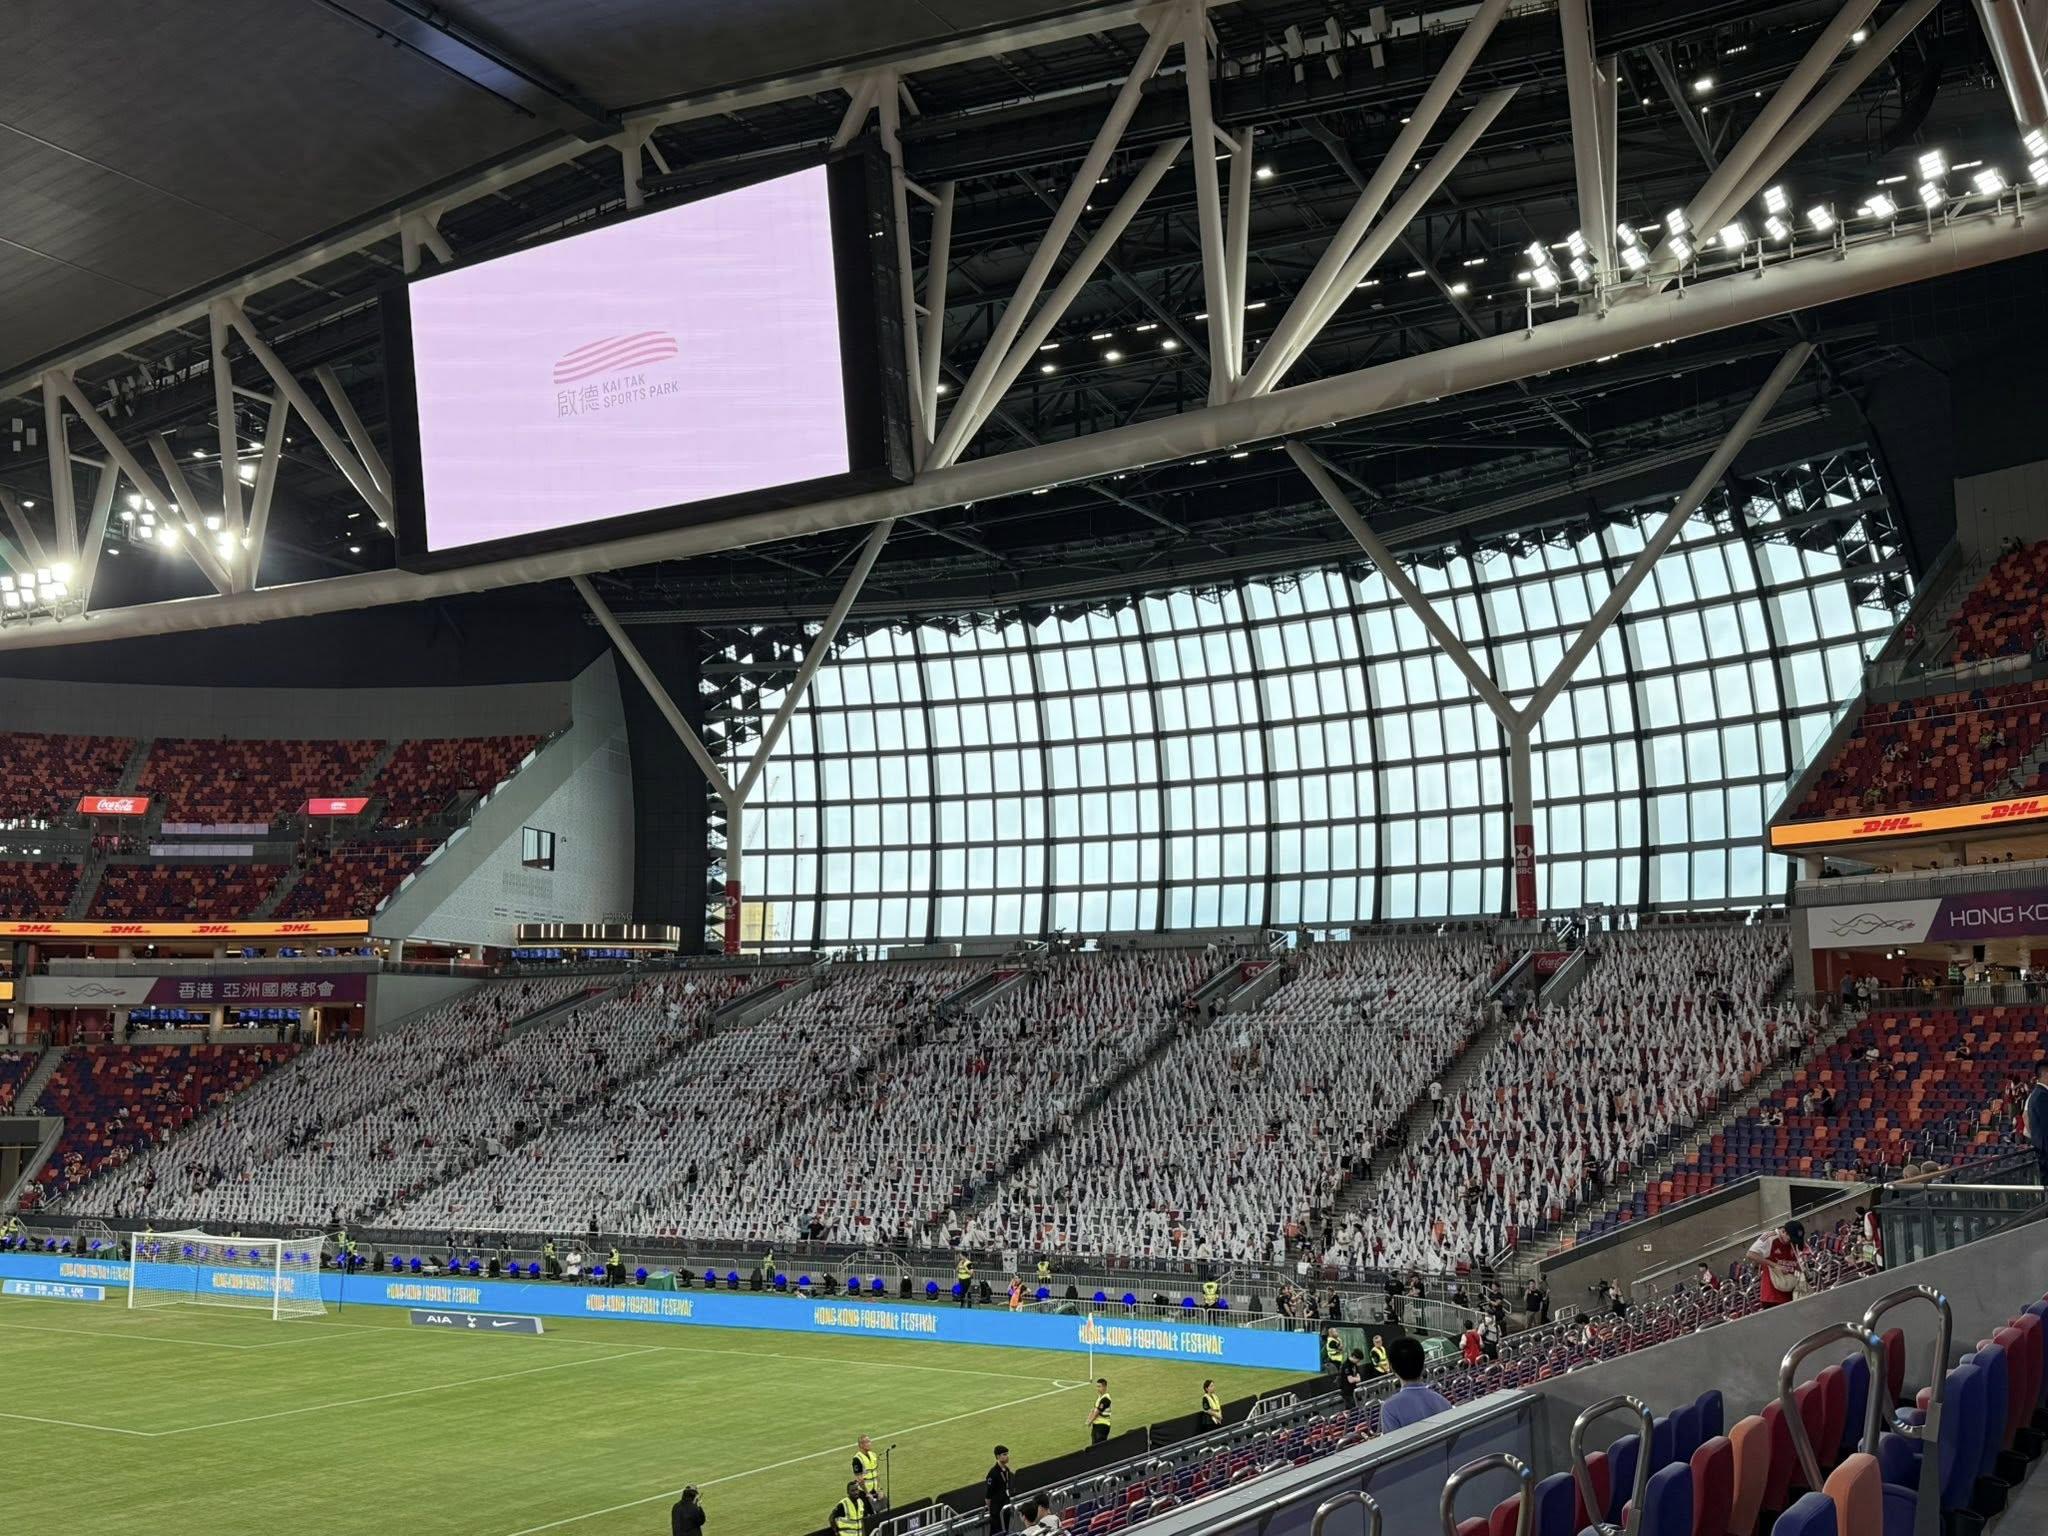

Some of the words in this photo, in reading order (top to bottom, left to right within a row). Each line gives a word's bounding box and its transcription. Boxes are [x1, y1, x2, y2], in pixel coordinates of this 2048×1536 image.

[602, 378, 621, 394] KAI
[624, 373, 646, 389] TAK
[557, 384, 600, 418] 啟德
[603, 388, 646, 409] SPORTS
[650, 380, 680, 398] PARK
[1991, 800, 2041, 818] DHL
[1863, 817, 1913, 833] DHL
[1950, 906, 2013, 927] HONG
[17, 924, 52, 933] DHL
[110, 924, 144, 933] DHL
[199, 924, 230, 933] DHL
[282, 923, 312, 932] DHL
[178, 982, 214, 999] 香港
[222, 980, 335, 998] 亞洲國際都會
[426, 1315, 452, 1324] AIA
[901, 1312, 938, 1333] FESTIVAL
[1107, 1326, 1131, 1347] KONG
[1133, 1328, 1178, 1351] FOOTBALL
[1181, 1332, 1224, 1355] FESTIVAL
